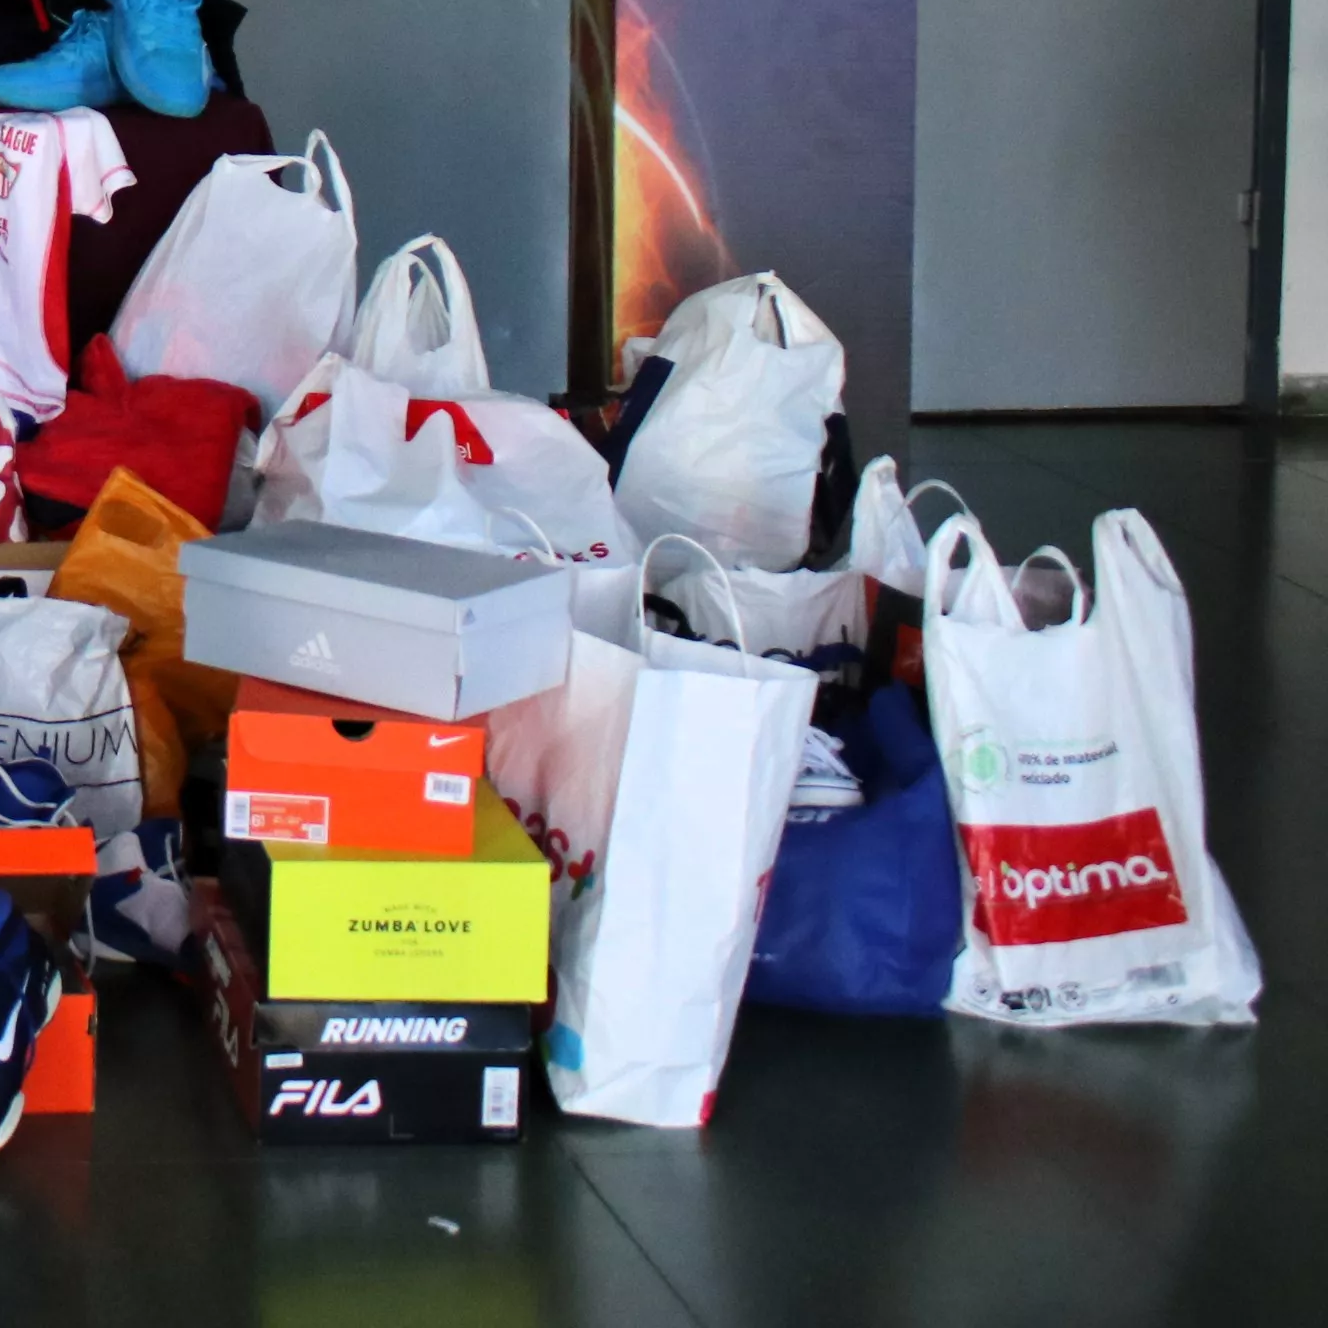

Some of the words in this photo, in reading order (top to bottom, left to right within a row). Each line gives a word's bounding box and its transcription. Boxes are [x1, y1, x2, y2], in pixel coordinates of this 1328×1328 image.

[1045, 752, 1060, 766] de
[1063, 740, 1118, 765] material
[348, 919, 417, 932] ZUMBA
[424, 919, 472, 932] LOVE
[321, 1017, 468, 1044] RUNNING
[269, 1079, 382, 1116] FILA
